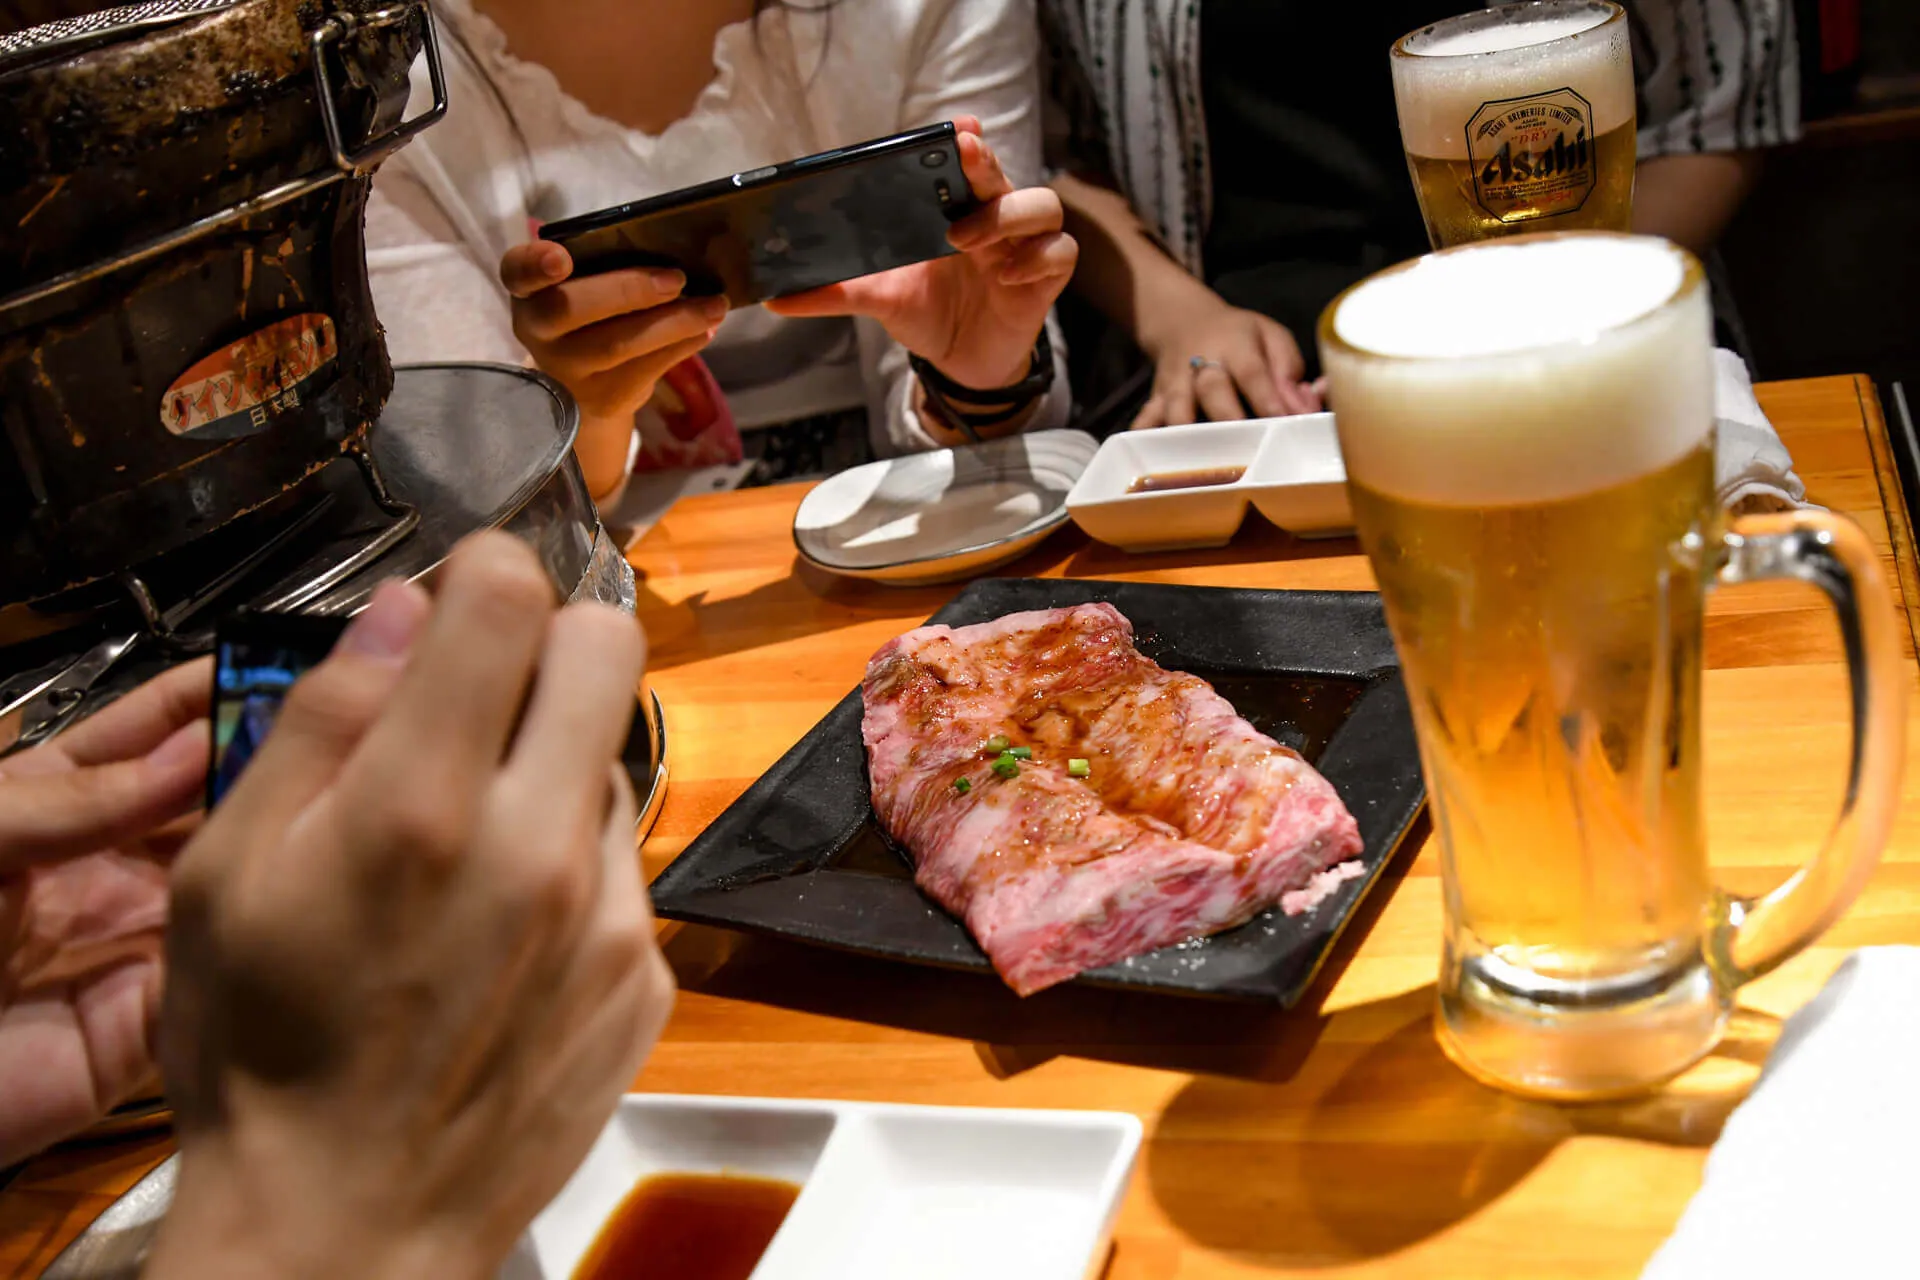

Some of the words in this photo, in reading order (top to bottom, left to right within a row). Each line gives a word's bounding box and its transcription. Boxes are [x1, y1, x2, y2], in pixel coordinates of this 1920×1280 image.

[1488, 120, 1506, 138] ASAHI
[1508, 106, 1546, 123] BREWERIES
[1549, 108, 1573, 126] LIMITED
[1481, 125, 1587, 185] Asahi
